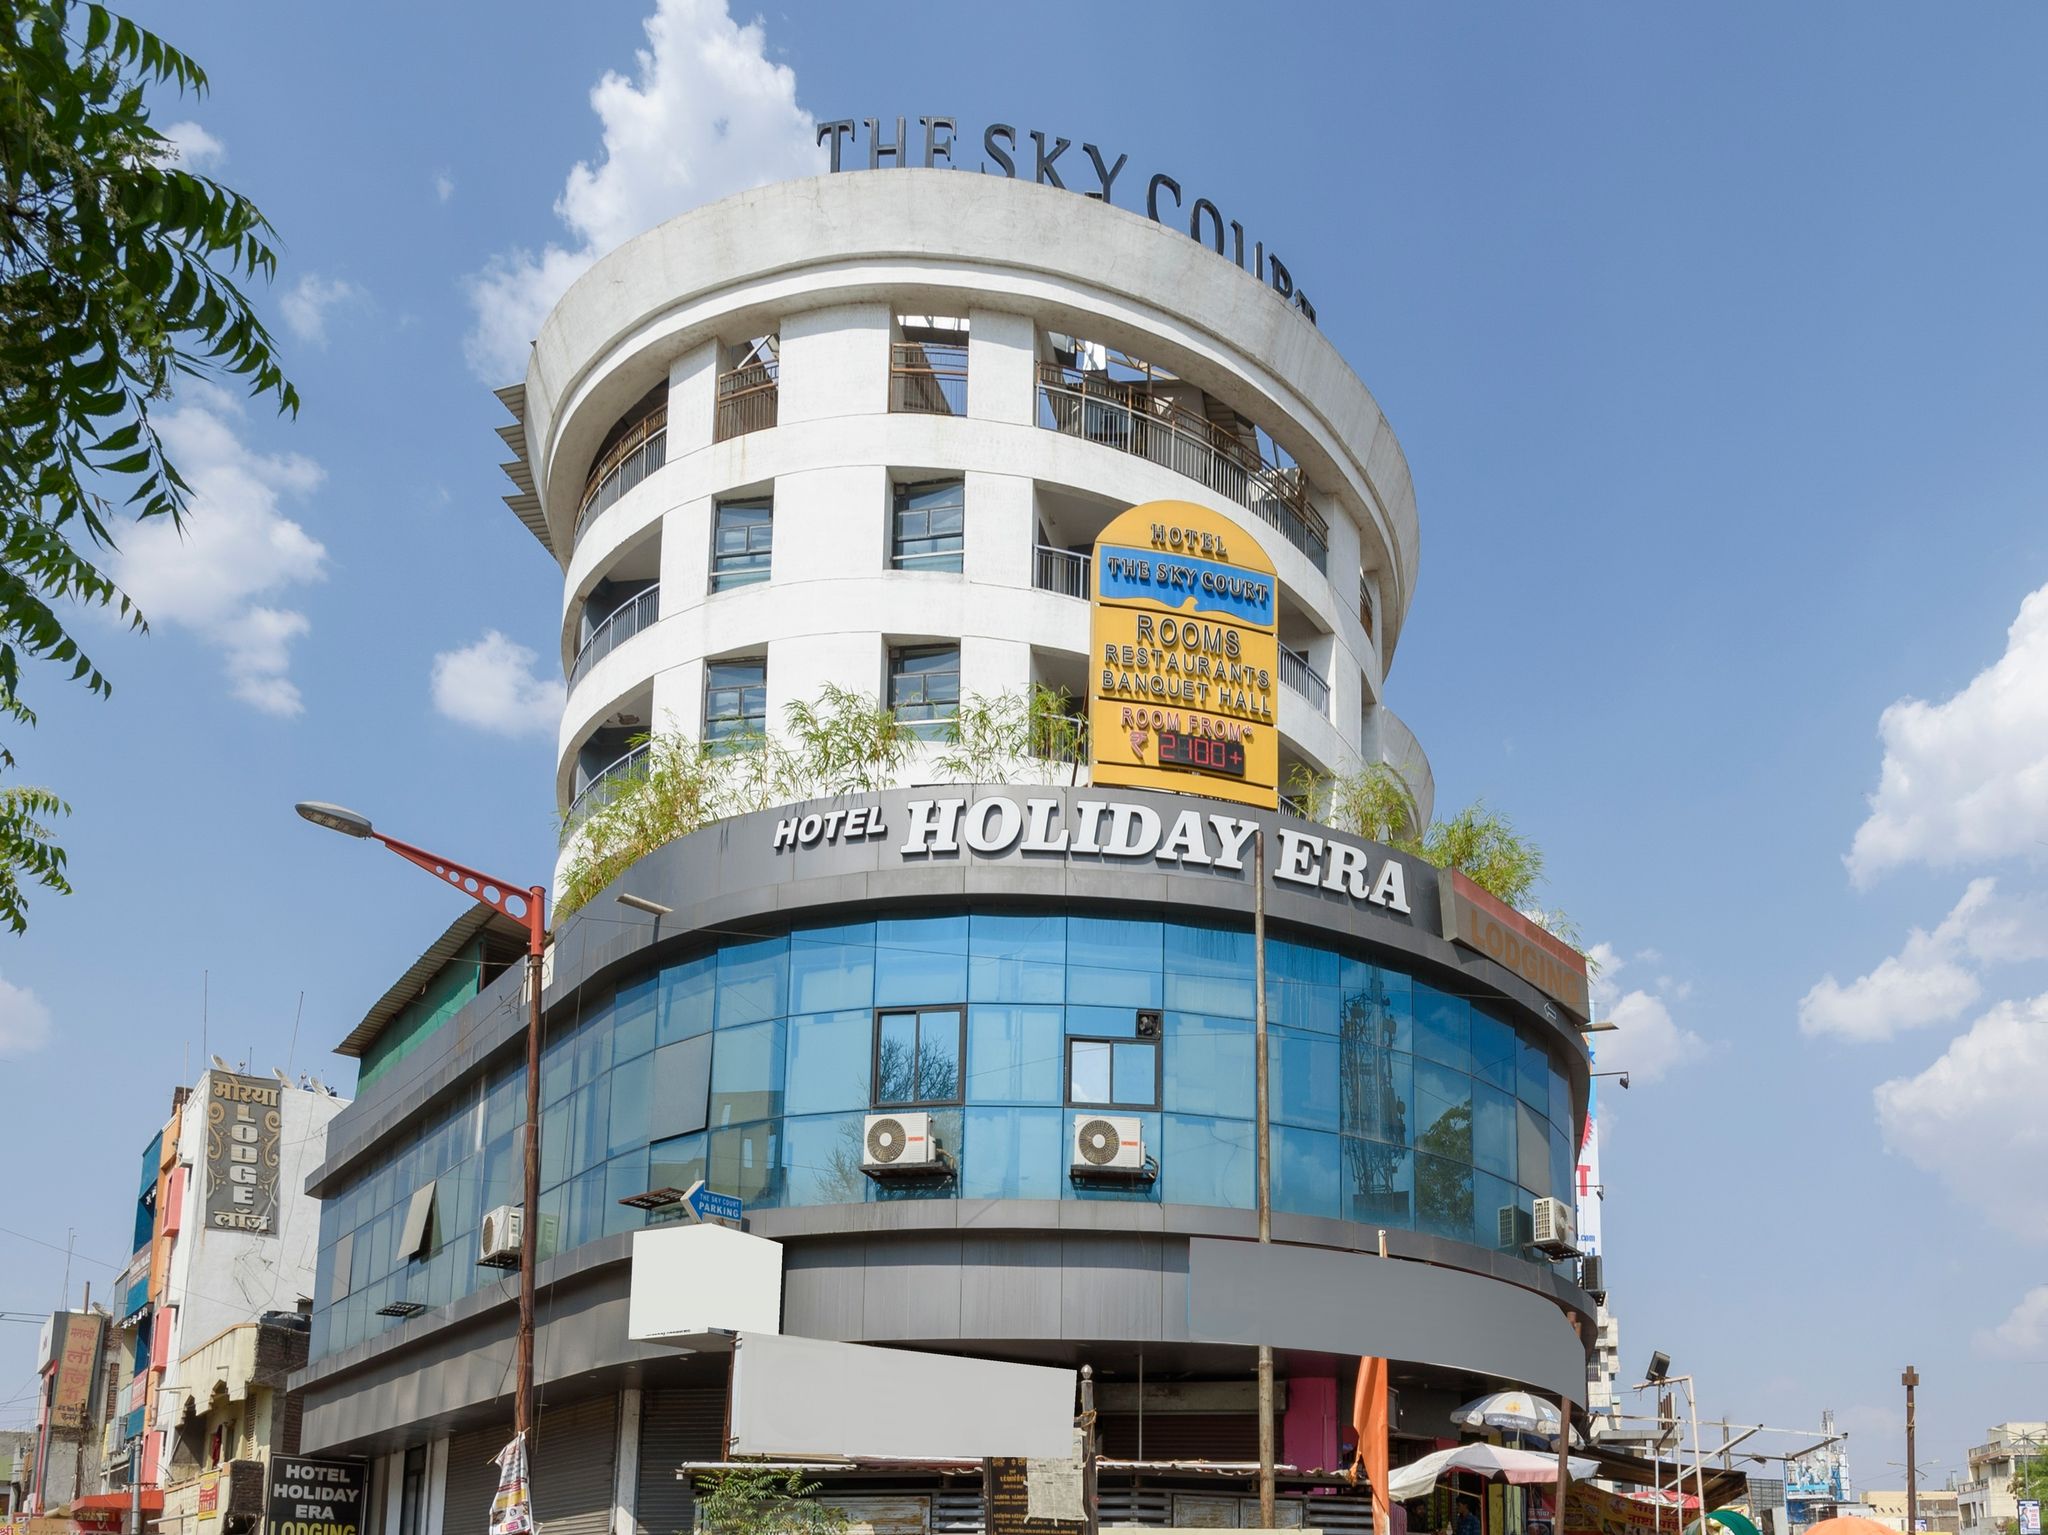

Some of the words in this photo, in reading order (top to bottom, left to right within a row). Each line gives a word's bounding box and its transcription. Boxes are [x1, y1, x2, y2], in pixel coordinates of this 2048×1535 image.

[816, 116, 957, 173] THE
[981, 123, 1128, 205] SKY
[1150, 523, 1227, 555] HOTEL
[1108, 556, 1151, 580] THE
[1157, 562, 1198, 587] SKY
[1200, 571, 1269, 602] COURT
[1136, 614, 1241, 658] ROOMS
[1104, 643, 1270, 689] RESTAURANTS
[1102, 669, 1209, 702] BANQUET
[1219, 686, 1271, 715] HALL
[1121, 706, 1180, 732] ROOM
[773, 805, 888, 849] HOTEL
[900, 796, 1261, 870] HOLIDAY
[1273, 826, 1412, 914] ERA
[1471, 907, 1579, 1003] LODGING
[213, 1076, 279, 1107] मोरया
[229, 1104, 259, 1205] LODGE
[698, 1201, 740, 1218] PARKING
[700, 1193, 710, 1201] THE
[711, 1194, 722, 1203] SKY
[722, 1198, 740, 1208] COURT
[285, 1464, 351, 1483] HOTEL
[273, 1483, 360, 1503] HOLIDAY
[269, 1520, 357, 1535] LODGING
[295, 1504, 335, 1520] ERA
